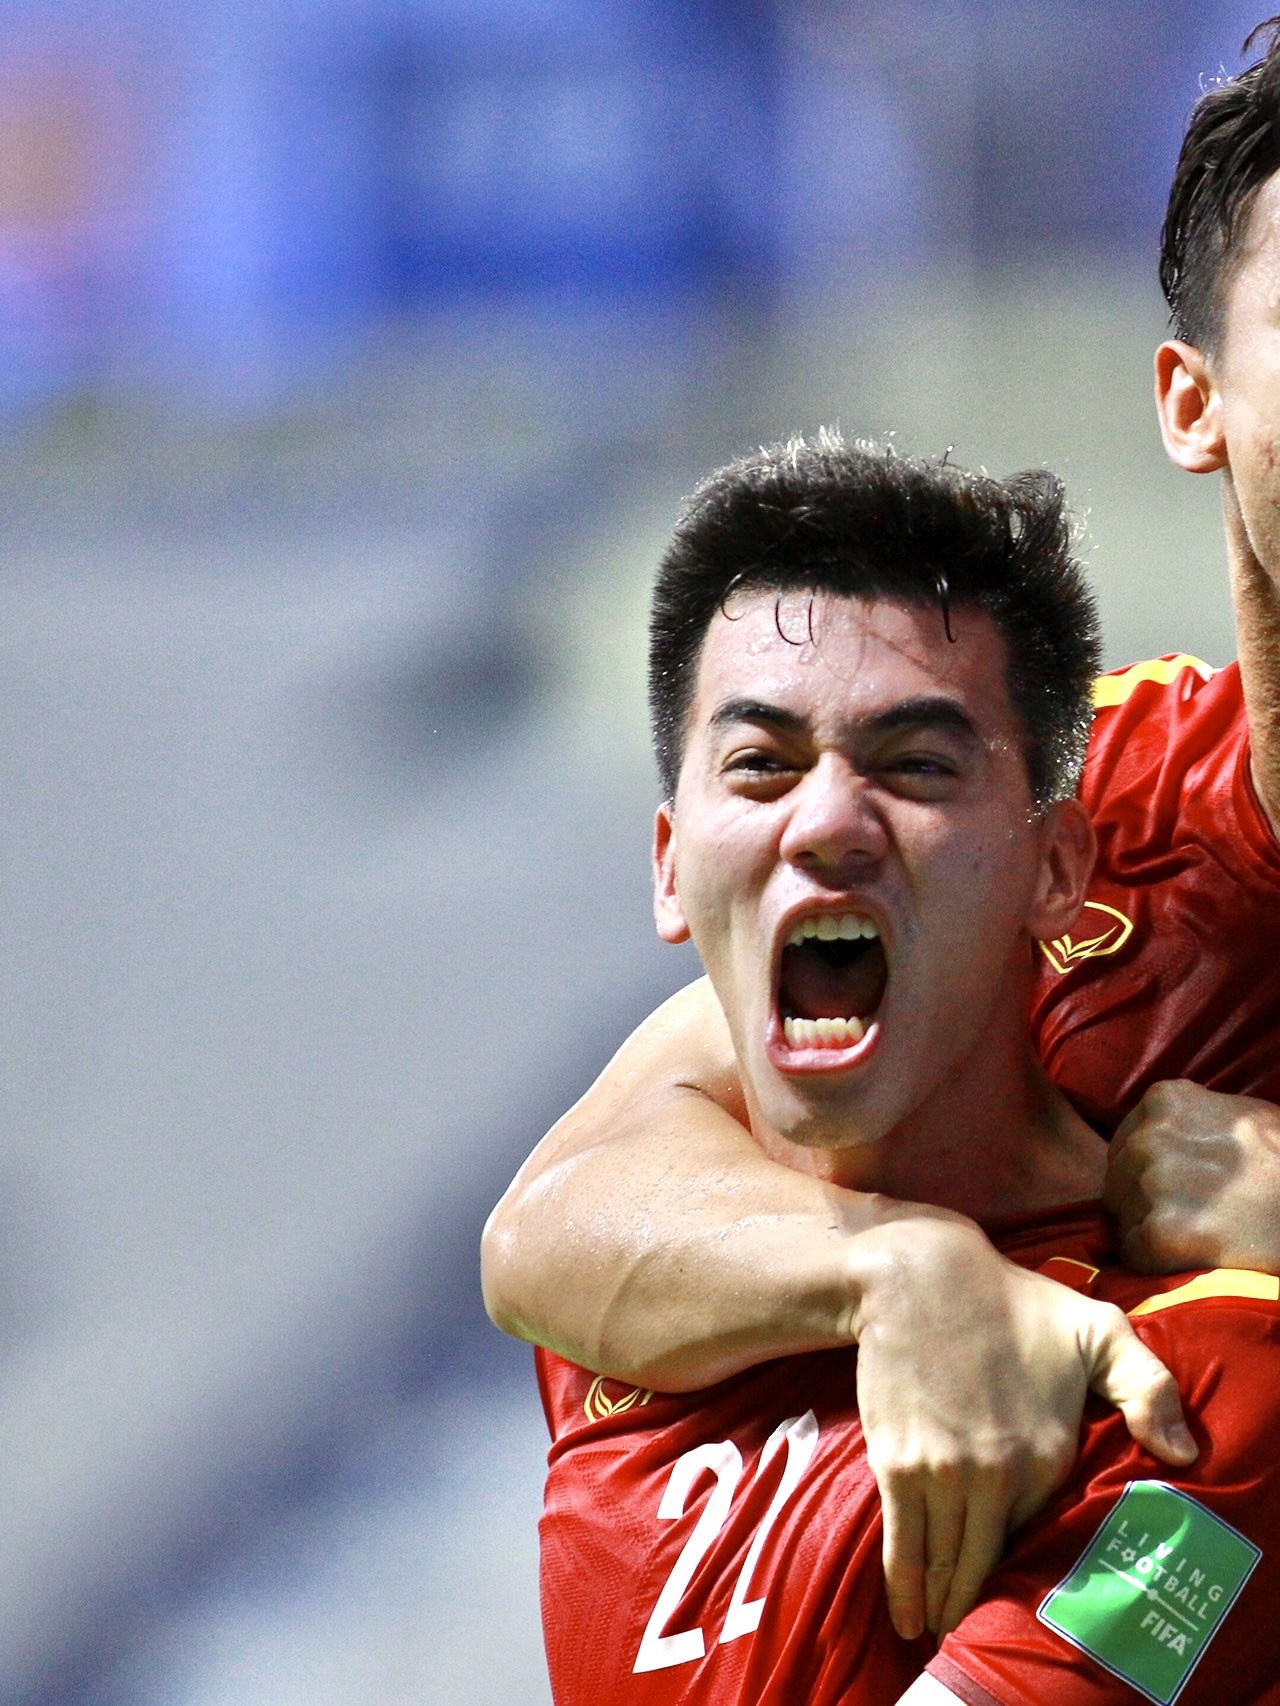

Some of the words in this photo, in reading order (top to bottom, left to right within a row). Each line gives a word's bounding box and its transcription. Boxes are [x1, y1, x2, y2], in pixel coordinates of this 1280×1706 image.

[1106, 1539, 1207, 1620] FOOTBALL
[1118, 1520, 1224, 1602] LIVING
[1140, 1610, 1189, 1656] FIFA
